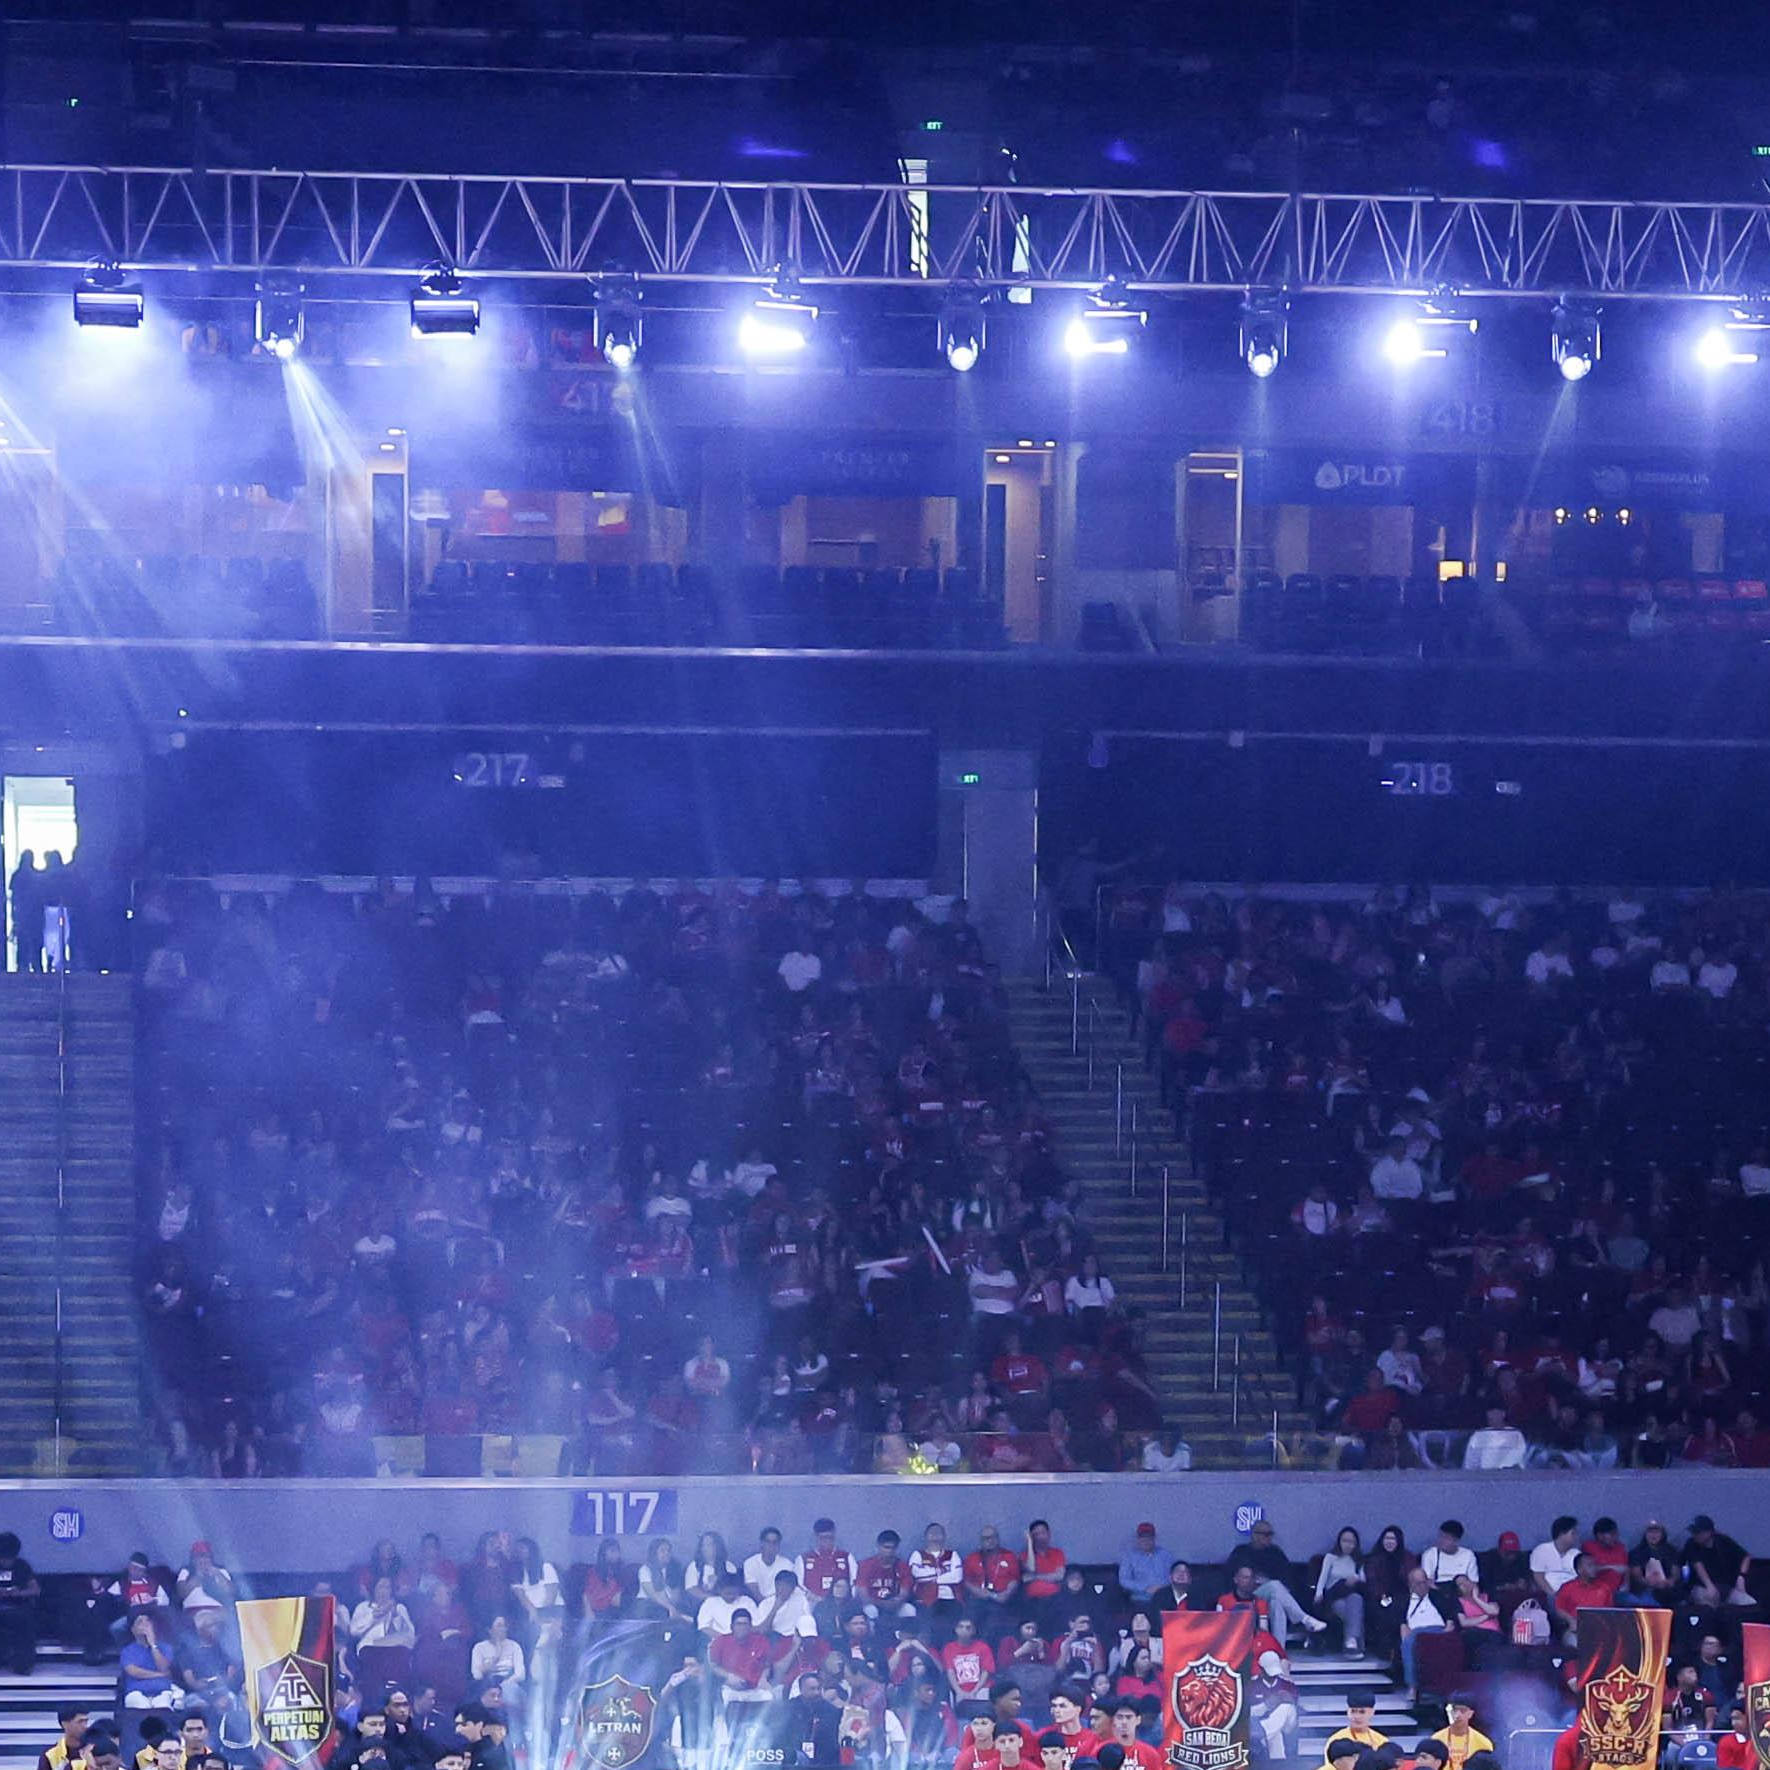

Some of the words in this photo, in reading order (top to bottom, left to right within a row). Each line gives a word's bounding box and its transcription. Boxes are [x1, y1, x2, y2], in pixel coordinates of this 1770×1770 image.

[467, 752, 530, 787] 217
[1391, 762, 1453, 795] 218
[587, 1491, 660, 1535] 117
[52, 1511, 81, 1539] SM
[270, 1723, 320, 1743] ALTAS
[588, 1720, 642, 1736] LETRAN
[1186, 1732, 1203, 1746] SAN
[1204, 1731, 1229, 1746] BEDA
[745, 1749, 785, 1762] POSS
[1177, 1748, 1201, 1764] RED
[1202, 1750, 1238, 1765] LIONS
